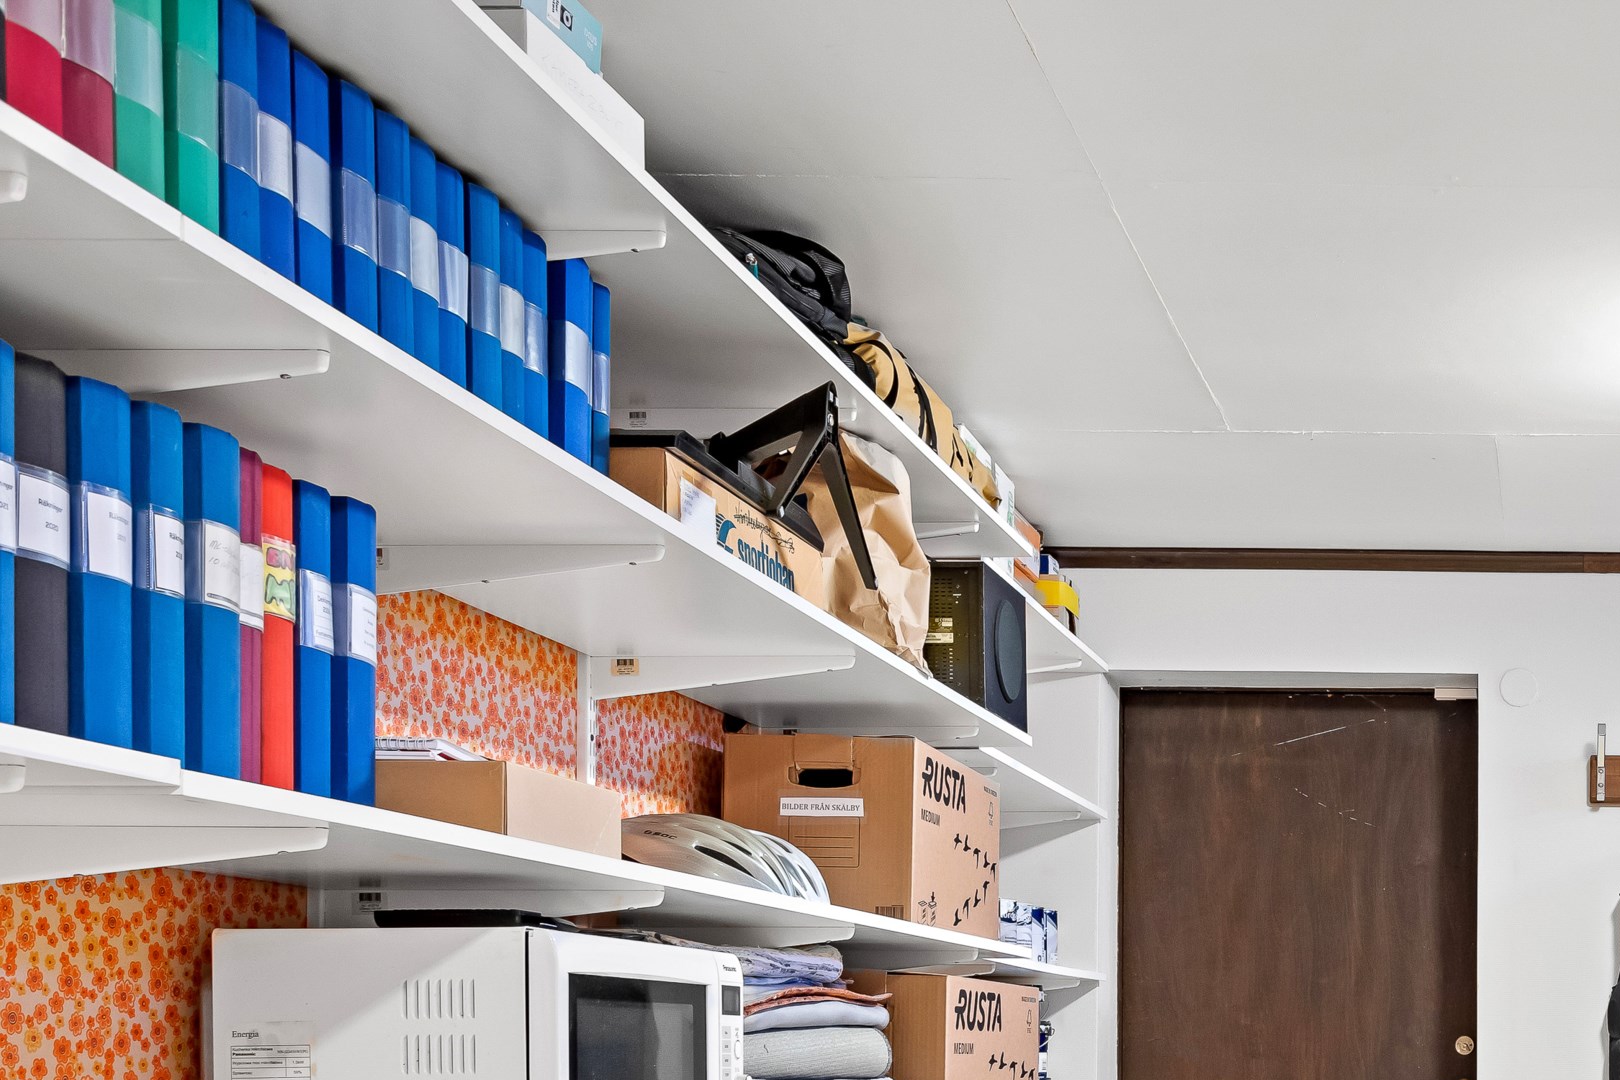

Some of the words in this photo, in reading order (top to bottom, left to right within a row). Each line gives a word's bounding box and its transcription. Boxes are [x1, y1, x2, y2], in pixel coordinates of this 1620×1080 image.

[922, 756, 967, 814] RUSTA
[781, 802, 809, 810] BILDER
[810, 802, 831, 811] FRÅN
[920, 808, 941, 827] MEDIUM
[954, 988, 1002, 1033] RUSTA
[231, 1030, 259, 1039] Energia
[953, 1042, 974, 1055] MEDIUM
